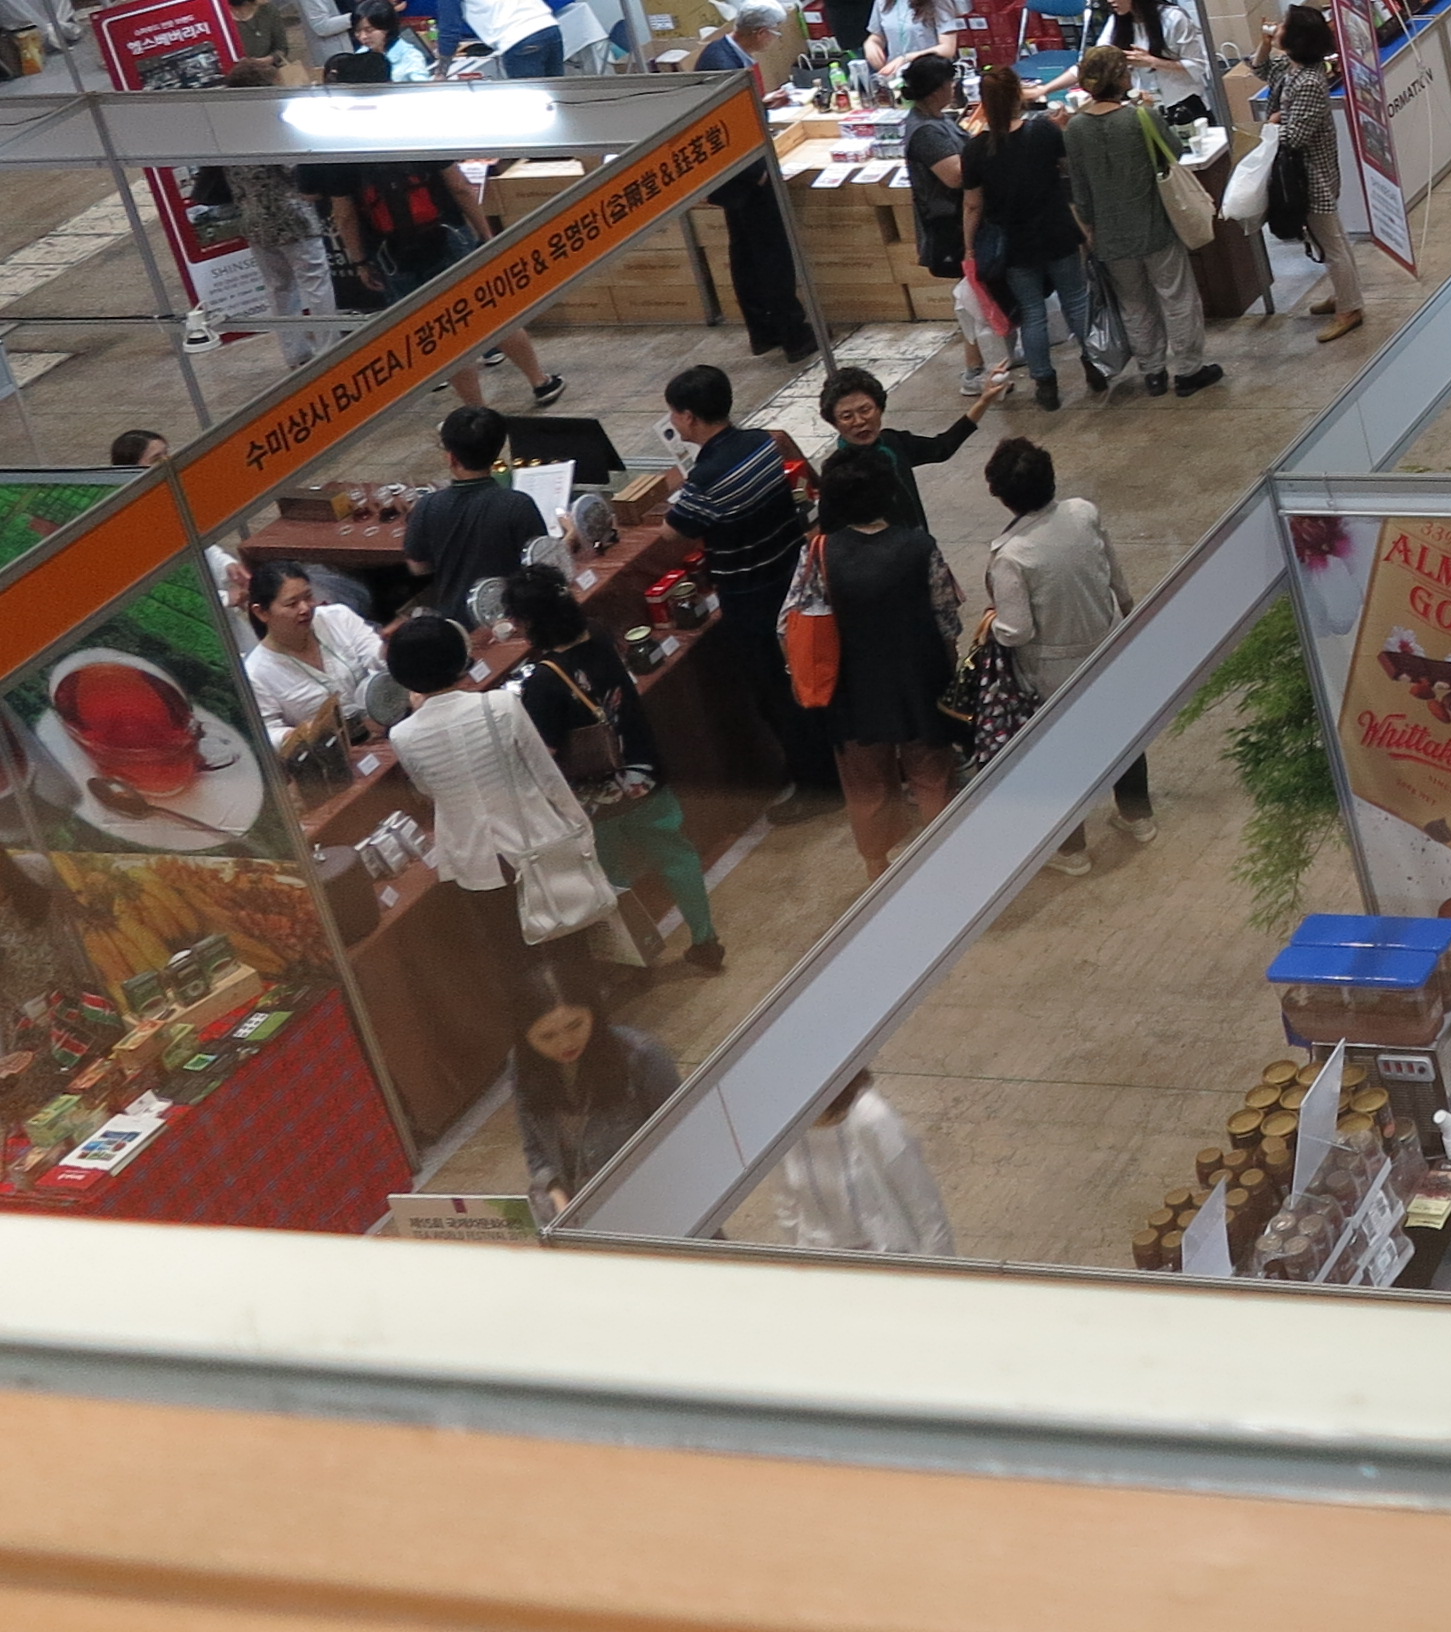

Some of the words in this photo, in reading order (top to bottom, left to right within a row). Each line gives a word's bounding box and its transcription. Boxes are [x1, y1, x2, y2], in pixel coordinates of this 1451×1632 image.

[126, 21, 211, 56] 헬스베버리지
[1386, 66, 1434, 119] ORMATION
[244, 396, 329, 472] 수미상사
[333, 349, 404, 417] BJTEA
[416, 299, 475, 358] 광저우
[474, 265, 532, 319] 익이당
[532, 249, 550, 274] &
[549, 205, 602, 261] 옥명당
[659, 162, 675, 188] &
